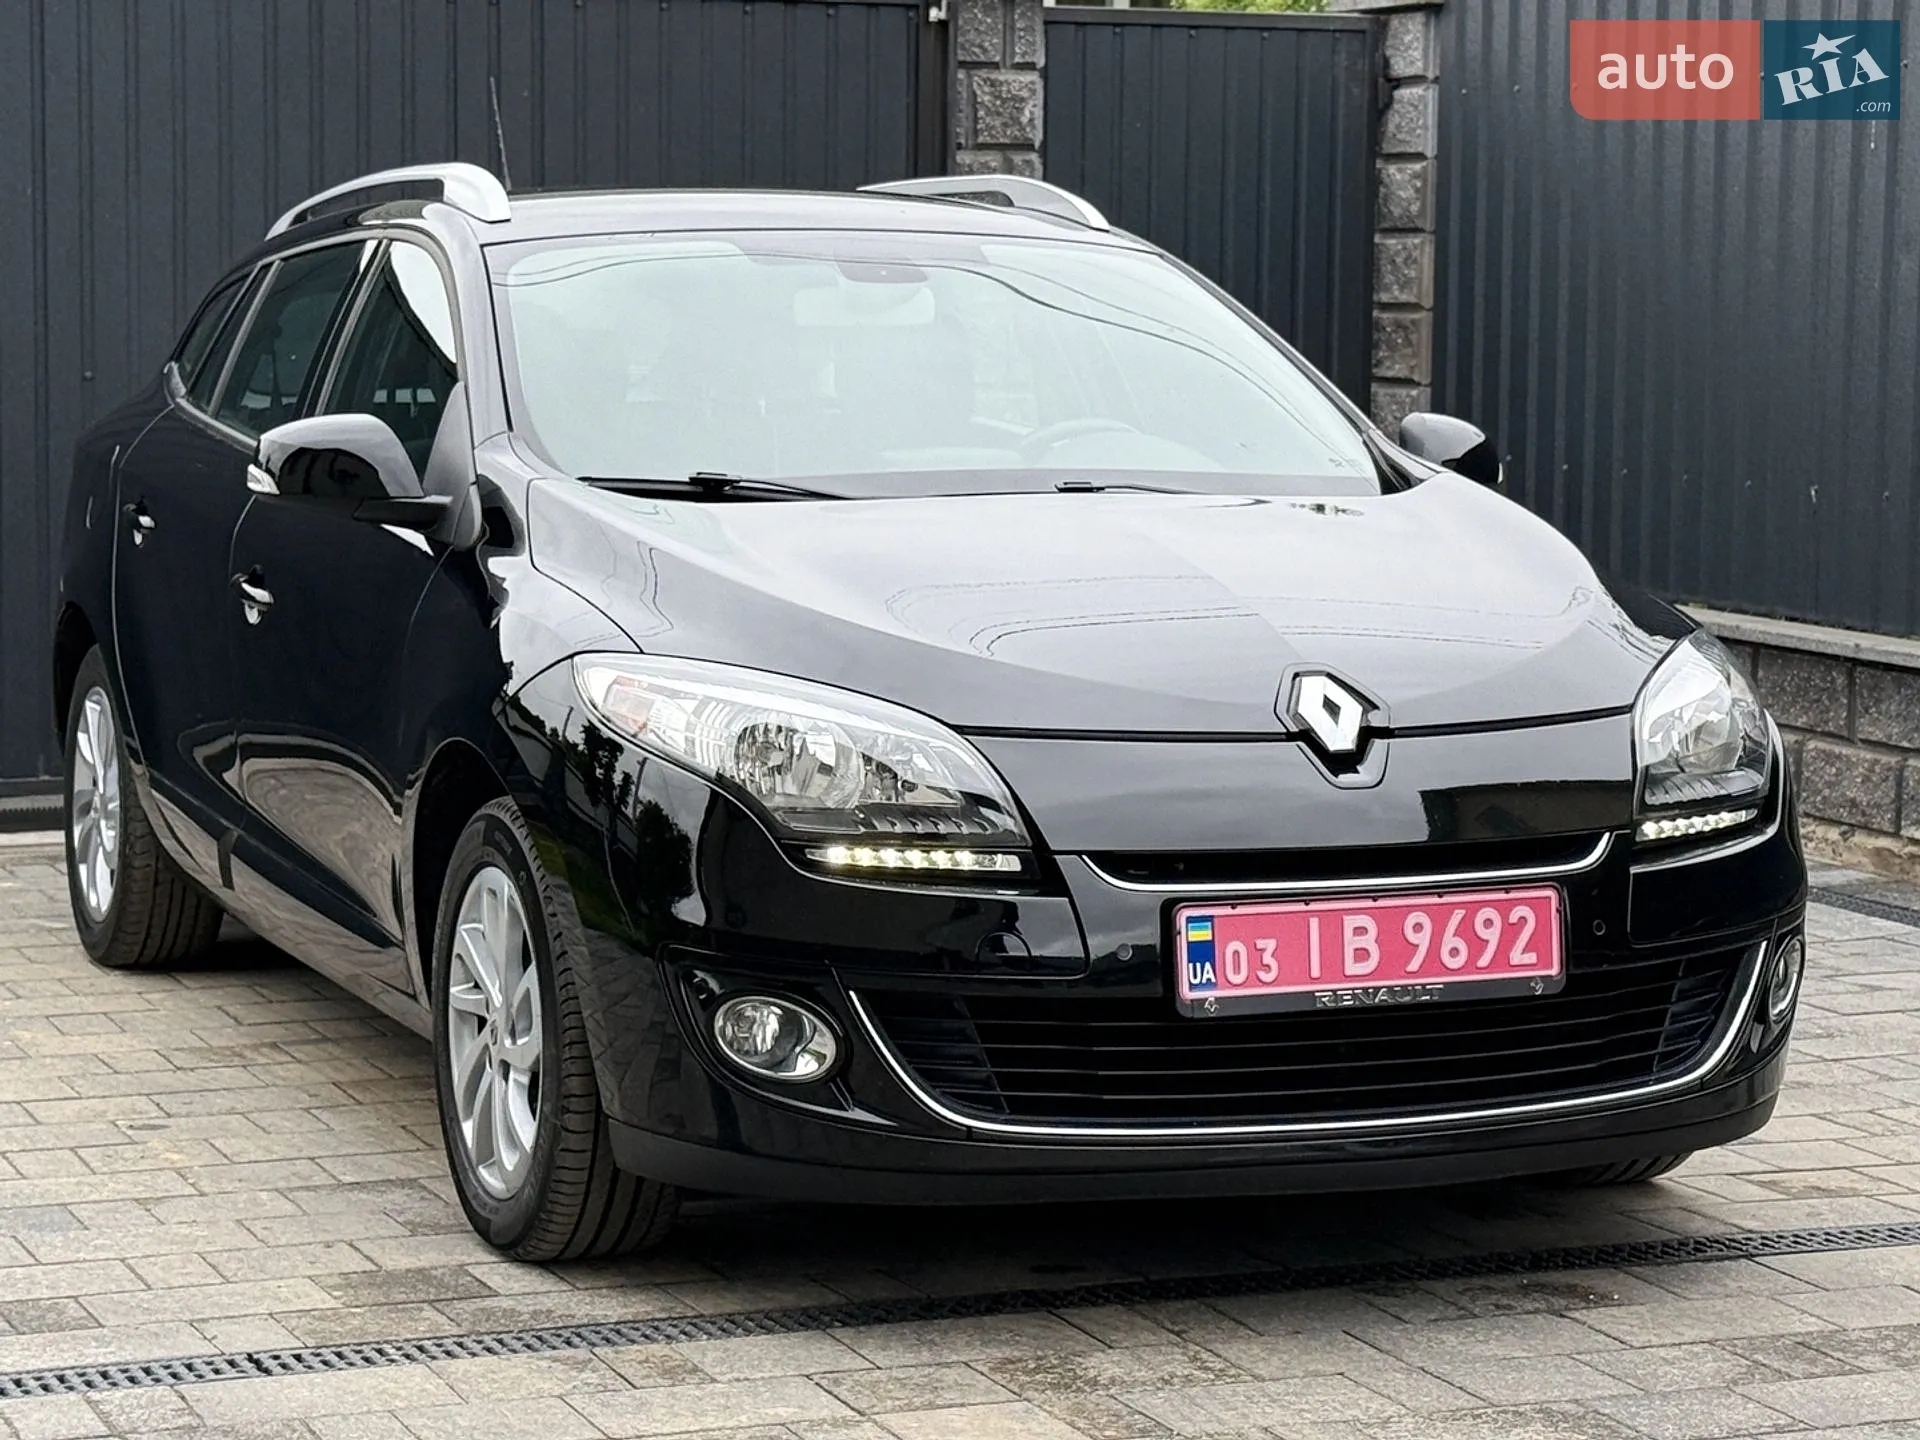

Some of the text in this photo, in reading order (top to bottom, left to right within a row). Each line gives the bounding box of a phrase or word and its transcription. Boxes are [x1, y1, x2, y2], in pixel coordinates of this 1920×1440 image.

[1224, 904, 1538, 985] 03 IB 9692
[1188, 961, 1216, 985] UA
[1314, 984, 1444, 1008] RENAULT
